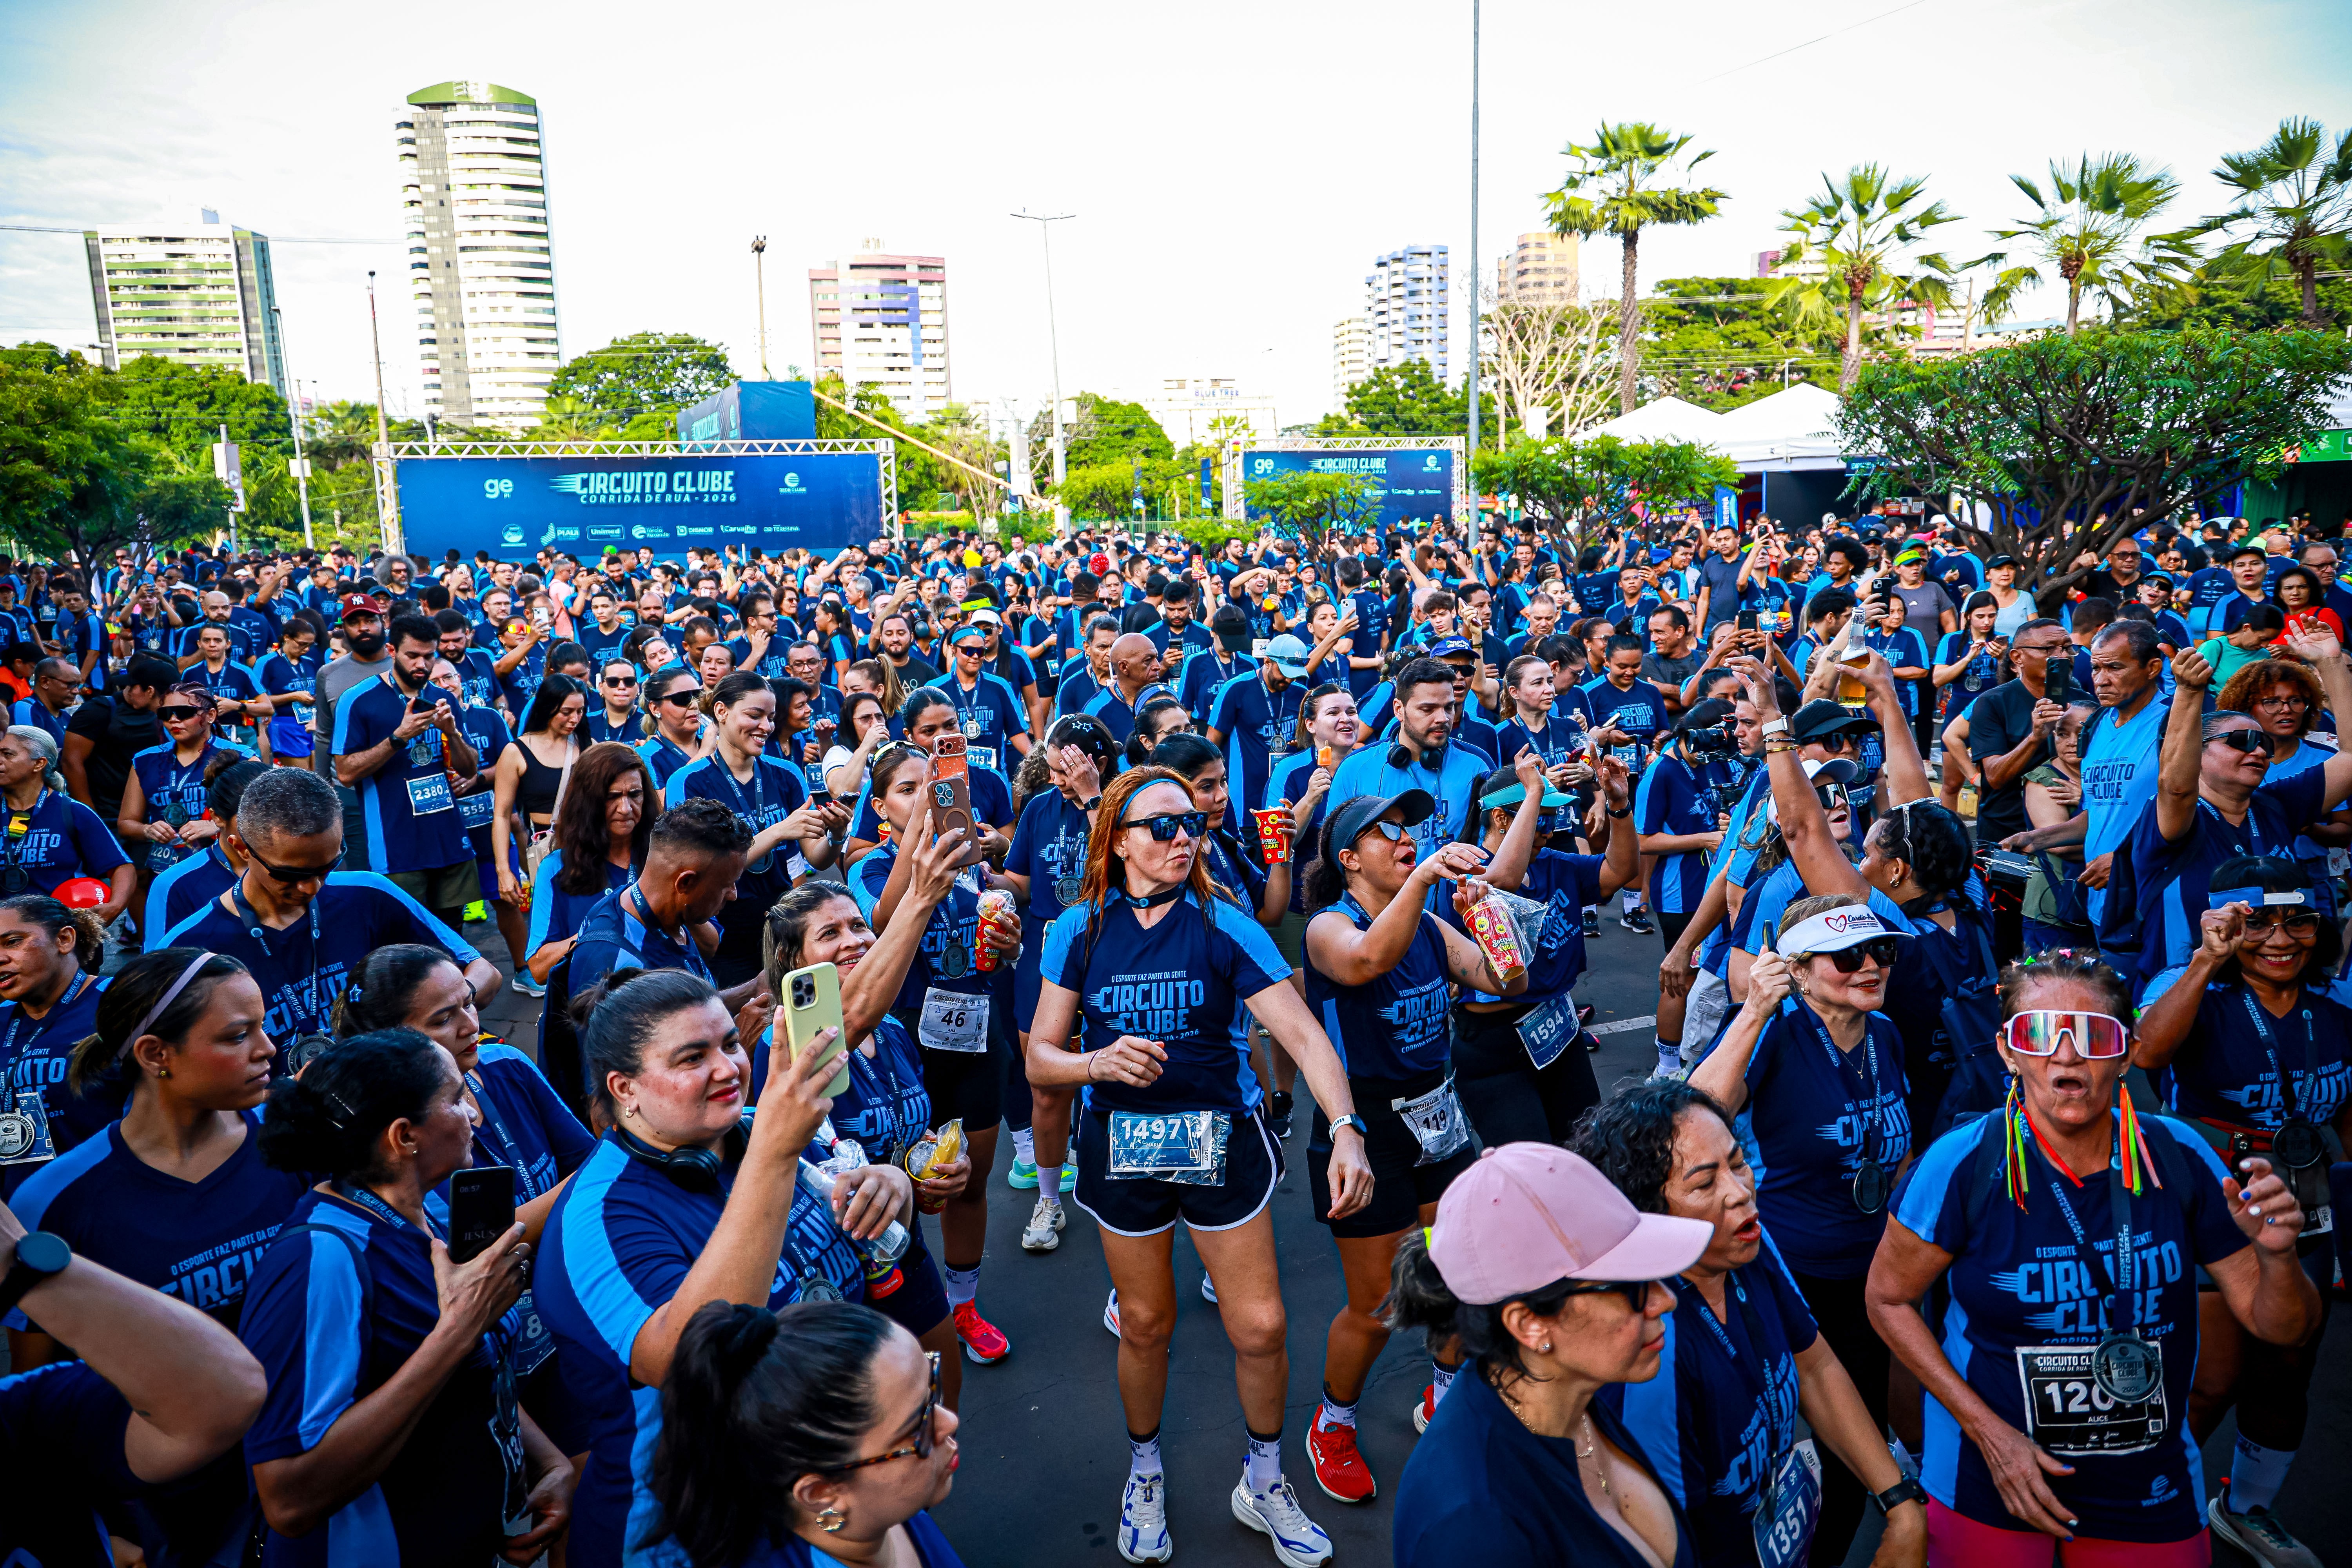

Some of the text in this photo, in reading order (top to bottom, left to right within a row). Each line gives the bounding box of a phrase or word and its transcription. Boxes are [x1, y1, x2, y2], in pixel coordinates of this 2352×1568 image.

[1254, 458, 1274, 474] ge
[1319, 457, 1387, 469] CIRCUITO CLUBE
[484, 478, 514, 499] ge
[575, 470, 735, 494] CIRCUITO CLUBE
[580, 494, 641, 504] CORRIDA
[645, 494, 661, 503] DE
[665, 493, 690, 503] RUA
[703, 493, 737, 503] 2026
[724, 525, 757, 533] Carvalho
[1614, 706, 1653, 717] CIRCUITO
[1624, 715, 1651, 726] CLUBE
[2084, 763, 2135, 783] CIRCUITO
[414, 784, 443, 801] 2380
[2092, 781, 2123, 800] CLUBE
[1558, 936, 1568, 947] RUA
[327, 961, 345, 973] GENTE
[1116, 974, 1137, 982] ESPORTE
[61, 980, 76, 1004] CIRCUITO
[1099, 980, 1204, 1012] CIRCUITO
[1403, 987, 1419, 996] ESPORTE
[284, 984, 307, 1020] CIRCUITO CLUBE
[1392, 985, 1449, 1025] CIRCUIT
[941, 1010, 966, 1027] 46
[1118, 1009, 1189, 1034] CLUBE
[1523, 1004, 1548, 1026] CIRCUITO CLUBE
[10, 1019, 20, 1037] CIRCUITO
[1180, 1029, 1199, 1039] 2026
[1530, 1010, 1564, 1045] 1594
[1401, 1041, 1426, 1053] CORRIDA
[1816, 1027, 1839, 1067] CIRCUITO CLUBE
[1868, 1034, 1877, 1059] CIRCUITO
[866, 1066, 877, 1080] CLUBE
[2293, 1070, 2304, 1078] FAZ
[2299, 1073, 2314, 1113] CIRCUITO CLUBE
[1859, 1100, 1869, 1109] FAZ
[1423, 1109, 1447, 1131] 119
[1122, 1119, 1181, 1140] 1497
[459, 1185, 480, 1193] 06:57
[356, 1190, 407, 1227] CIRCUITO CLUBE
[463, 1229, 496, 1241] JESUS
[171, 1229, 267, 1276] O ESPORTE FAZ PARTE DA
[2036, 1245, 2077, 1258] O ESPORTE
[844, 1281, 858, 1296] RUA
[881, 1278, 898, 1291] TERESINA
[1700, 1306, 1724, 1336] CIRCUITO
[2147, 1321, 2175, 1337] 2026
[2038, 1356, 2079, 1367] CIRCUITO
[2111, 1361, 2143, 1371] CIRCUITO
[2088, 1415, 2109, 1423] ALICE
[1768, 1495, 1808, 1565] 1351
